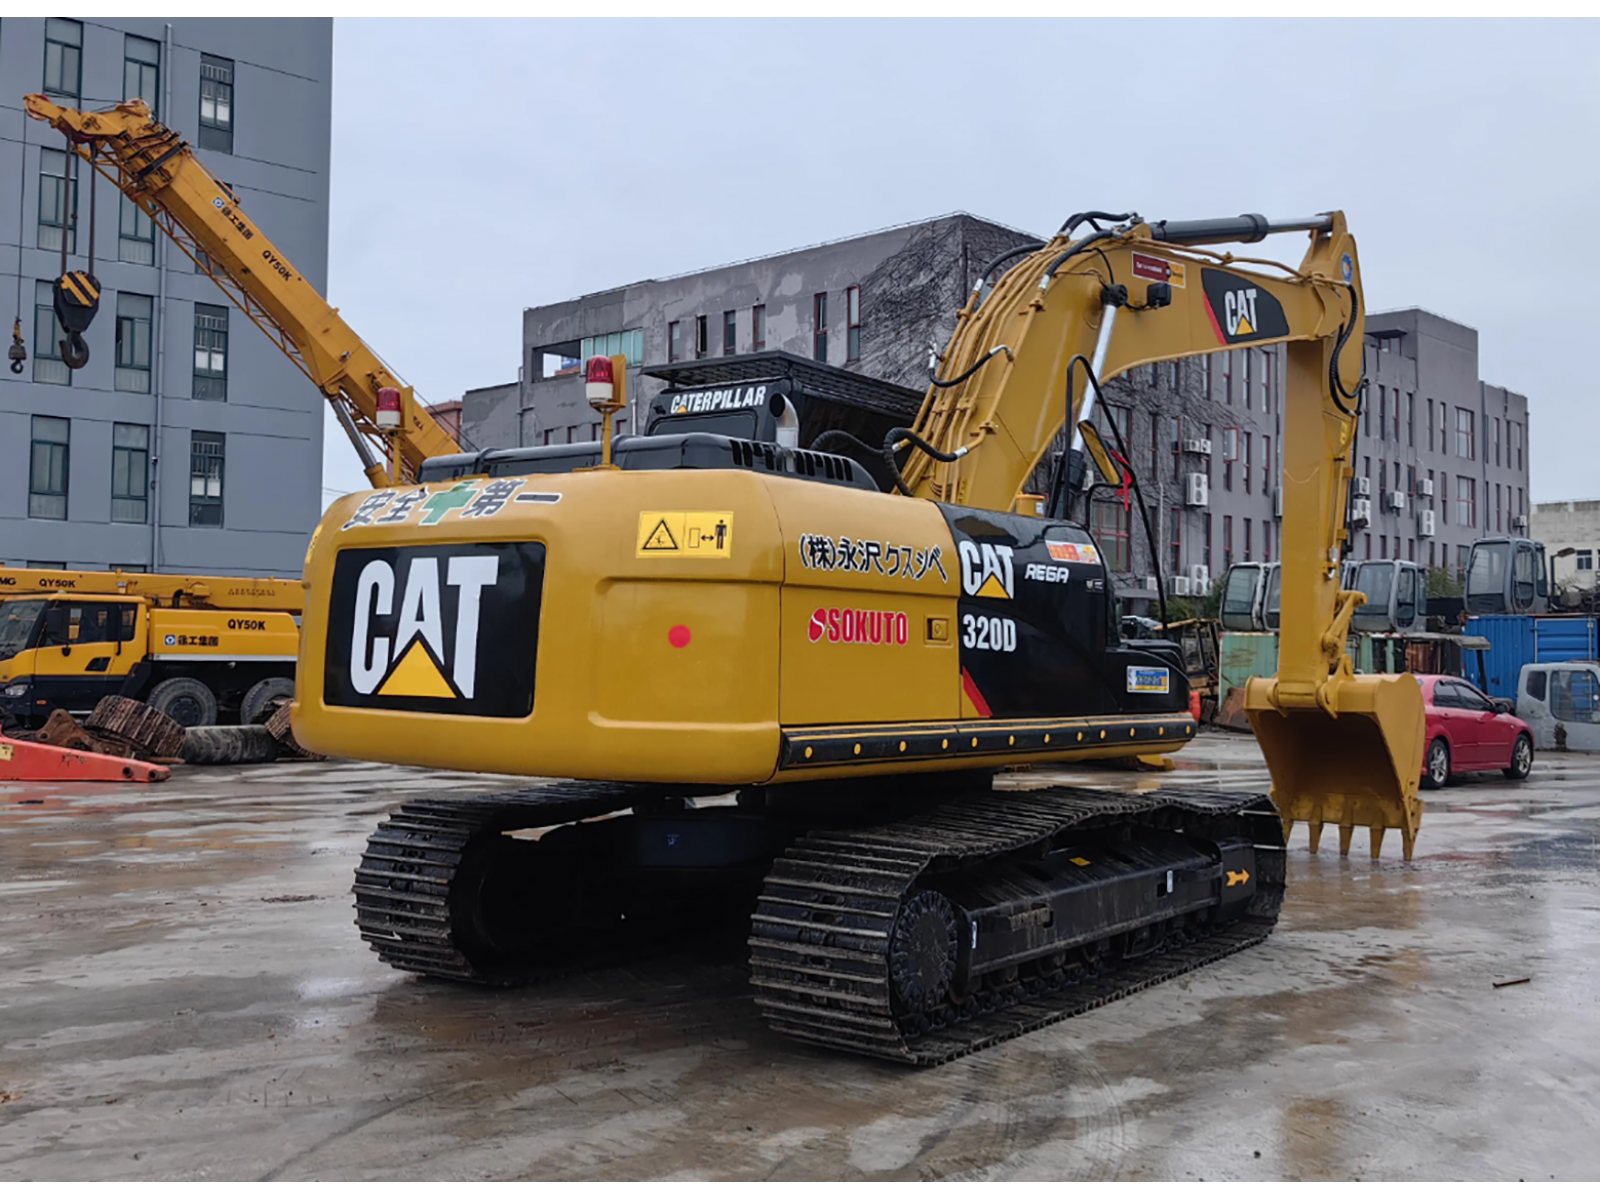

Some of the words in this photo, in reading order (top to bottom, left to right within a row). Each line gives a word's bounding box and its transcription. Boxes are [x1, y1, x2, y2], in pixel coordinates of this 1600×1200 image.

[262, 250, 293, 281] QY50K
[1223, 288, 1257, 336] CAT
[670, 385, 767, 414] CATERPILLAR
[39, 578, 76, 588] QY50K
[958, 540, 1015, 600] CAT
[227, 618, 266, 631] QY50K
[350, 555, 499, 700] CAT
[827, 607, 908, 646] SOKUTO
[962, 613, 1017, 652] 320D
